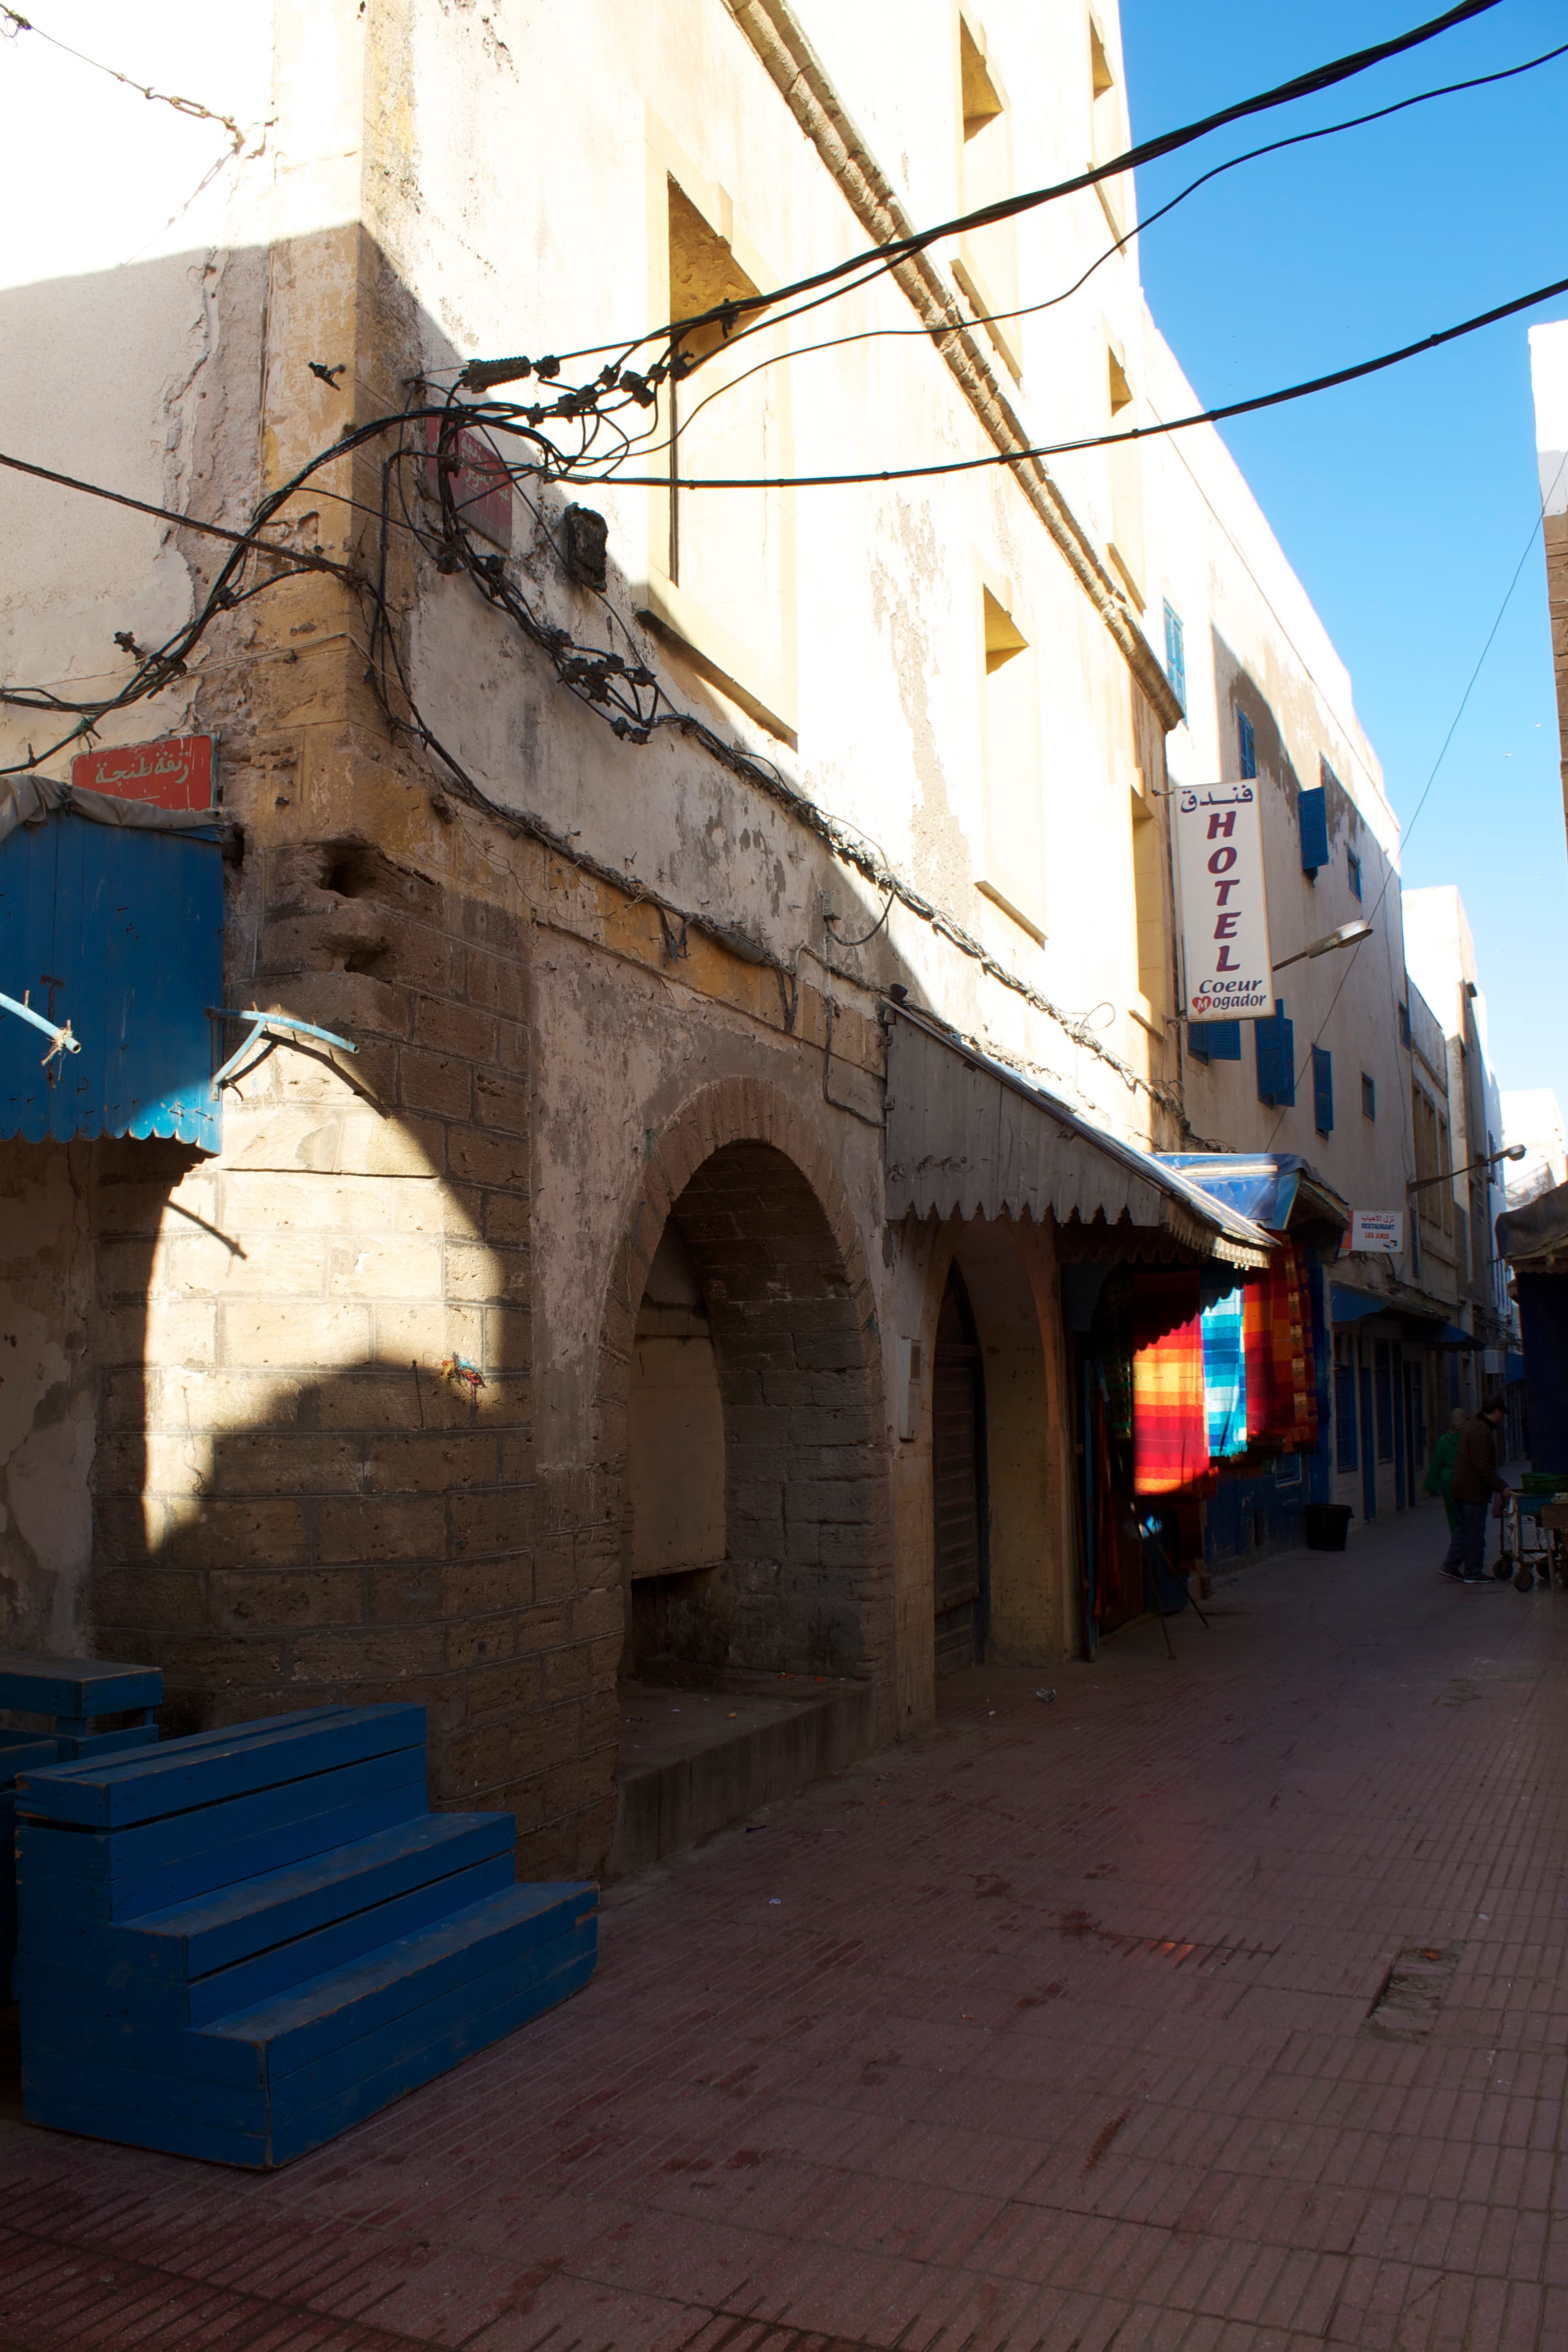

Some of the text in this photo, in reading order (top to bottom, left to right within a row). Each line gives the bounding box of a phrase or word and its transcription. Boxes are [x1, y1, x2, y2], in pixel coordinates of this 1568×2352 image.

[95, 748, 189, 787] زنقة طنجة
[1180, 784, 1253, 813] فندق
[1206, 810, 1242, 973] HOTEL
[1199, 979, 1262, 994] Coeur
[1194, 993, 1266, 1011] Mogador
